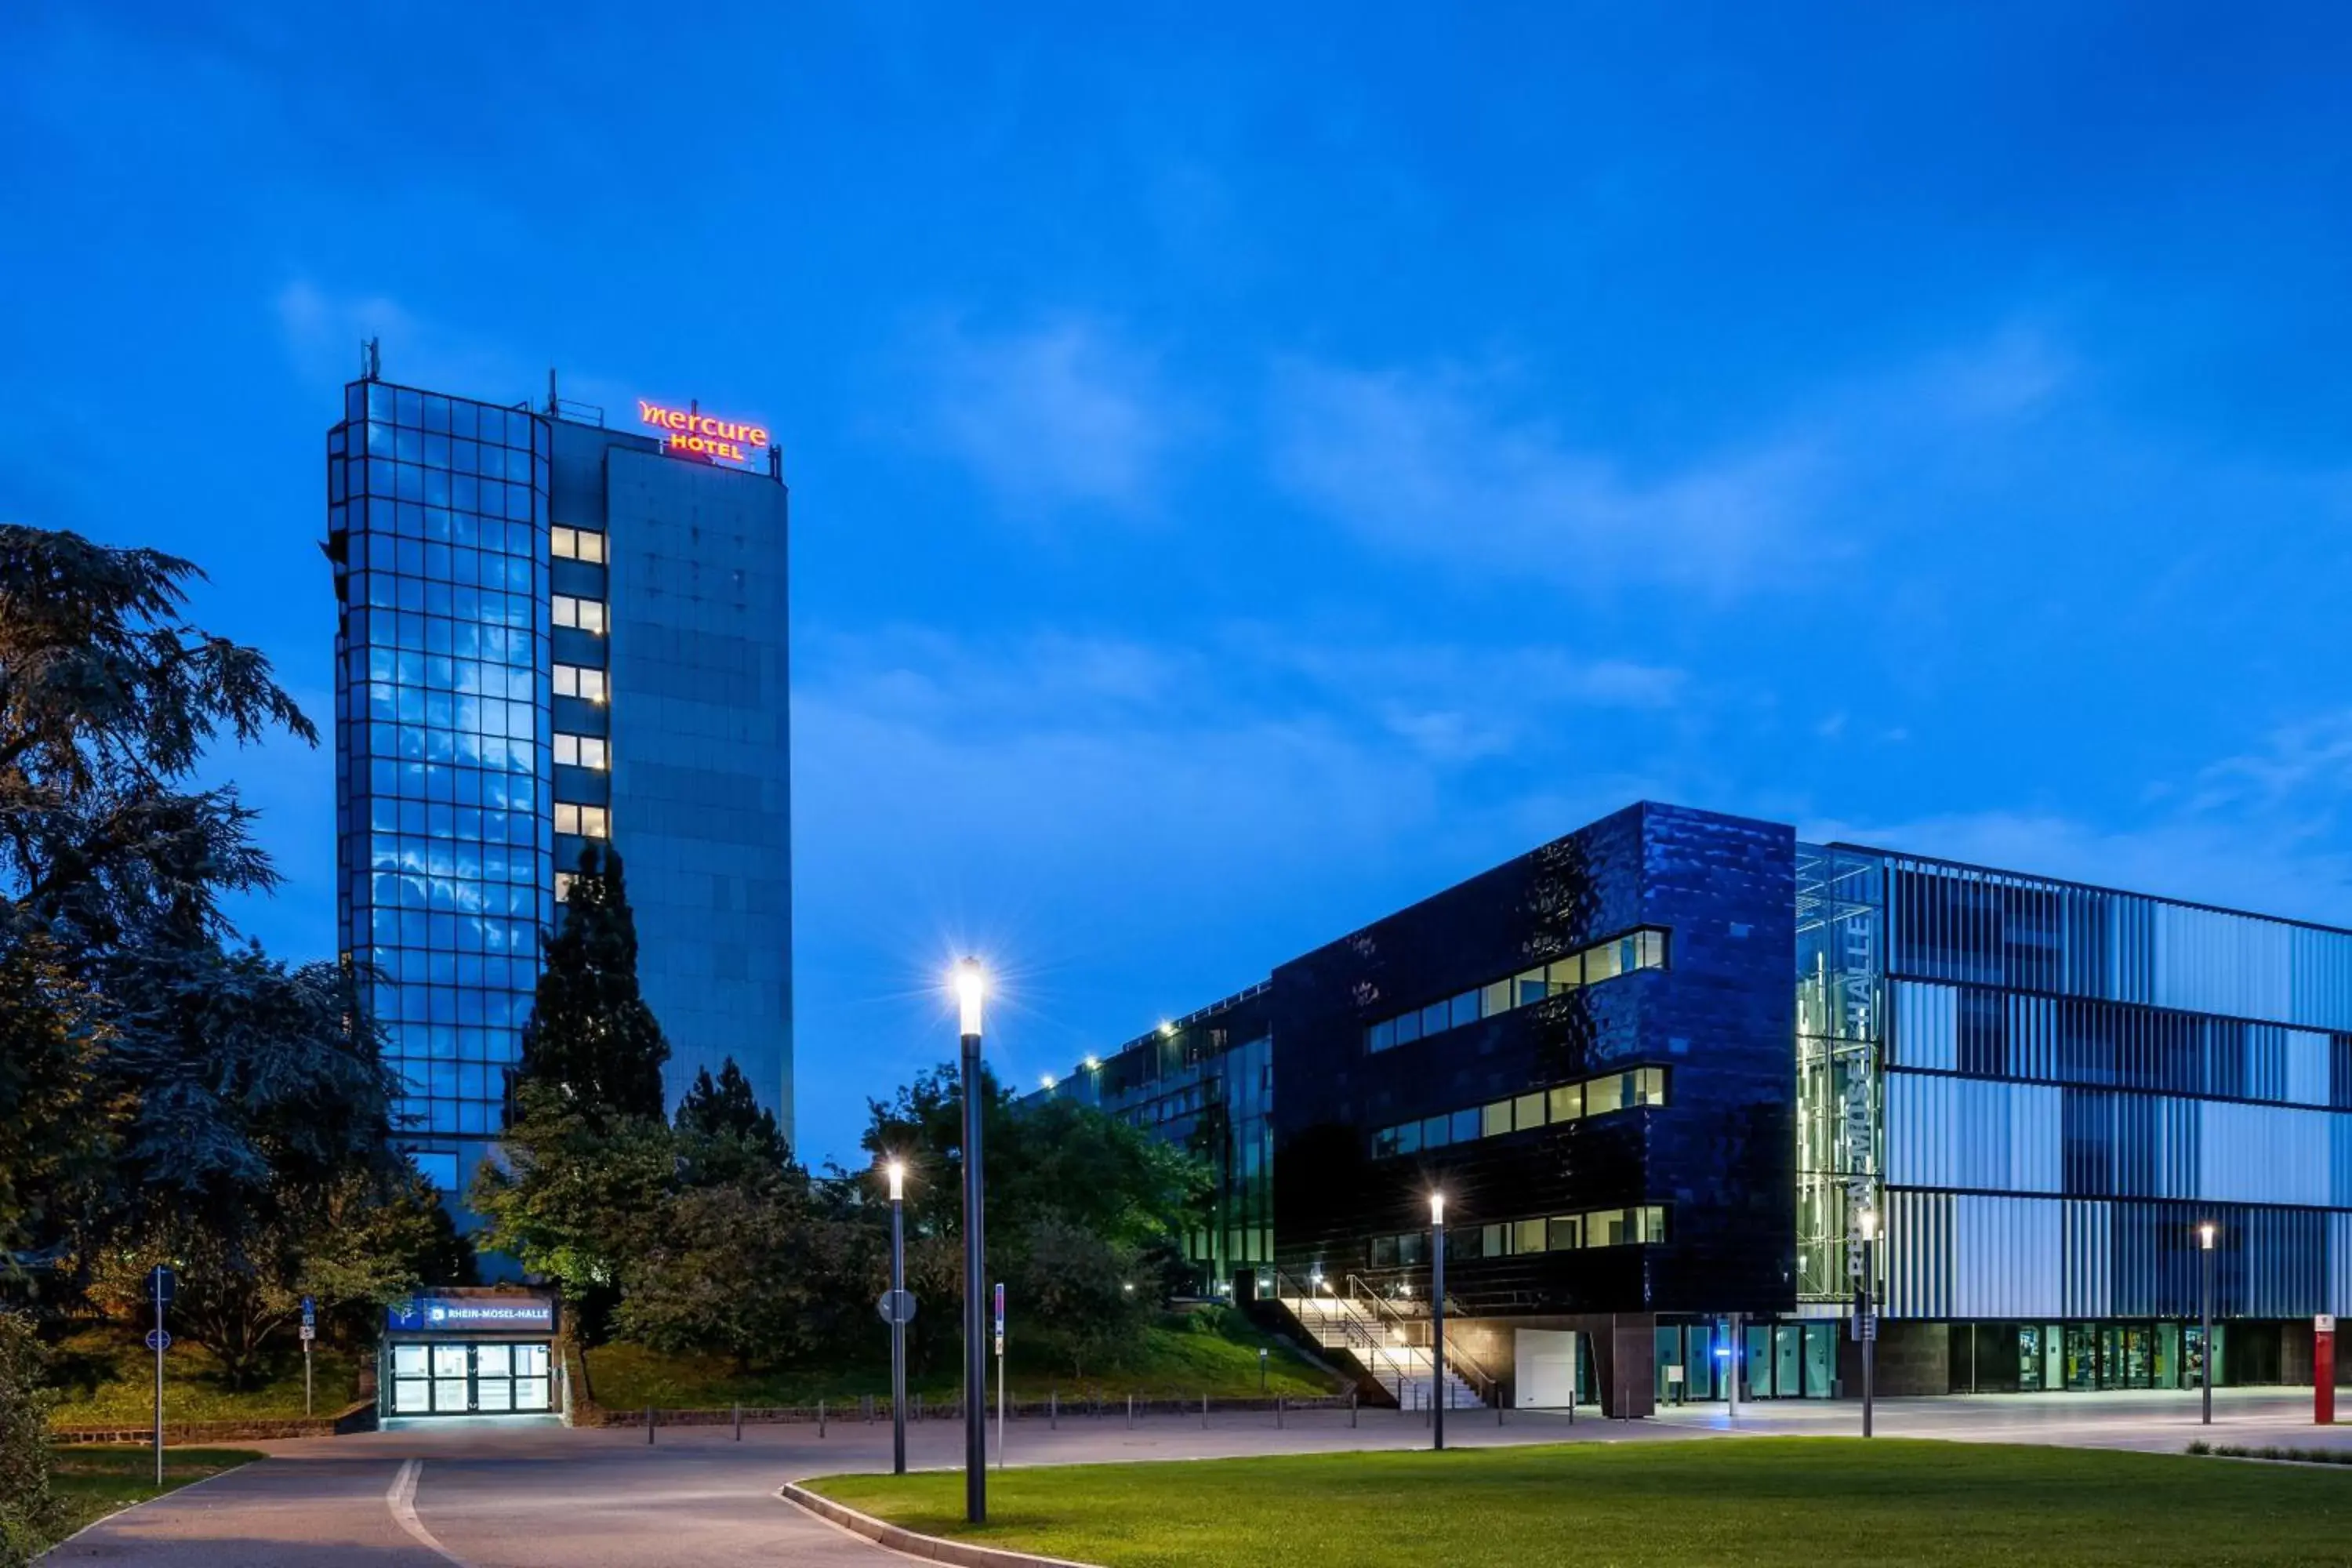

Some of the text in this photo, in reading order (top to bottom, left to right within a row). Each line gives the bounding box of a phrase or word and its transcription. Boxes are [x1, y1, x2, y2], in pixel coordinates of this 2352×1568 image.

[640, 401, 767, 446] mercure
[670, 433, 744, 460] HOTEL
[448, 1308, 550, 1319] RHEIN-MOSEL-HALLE
